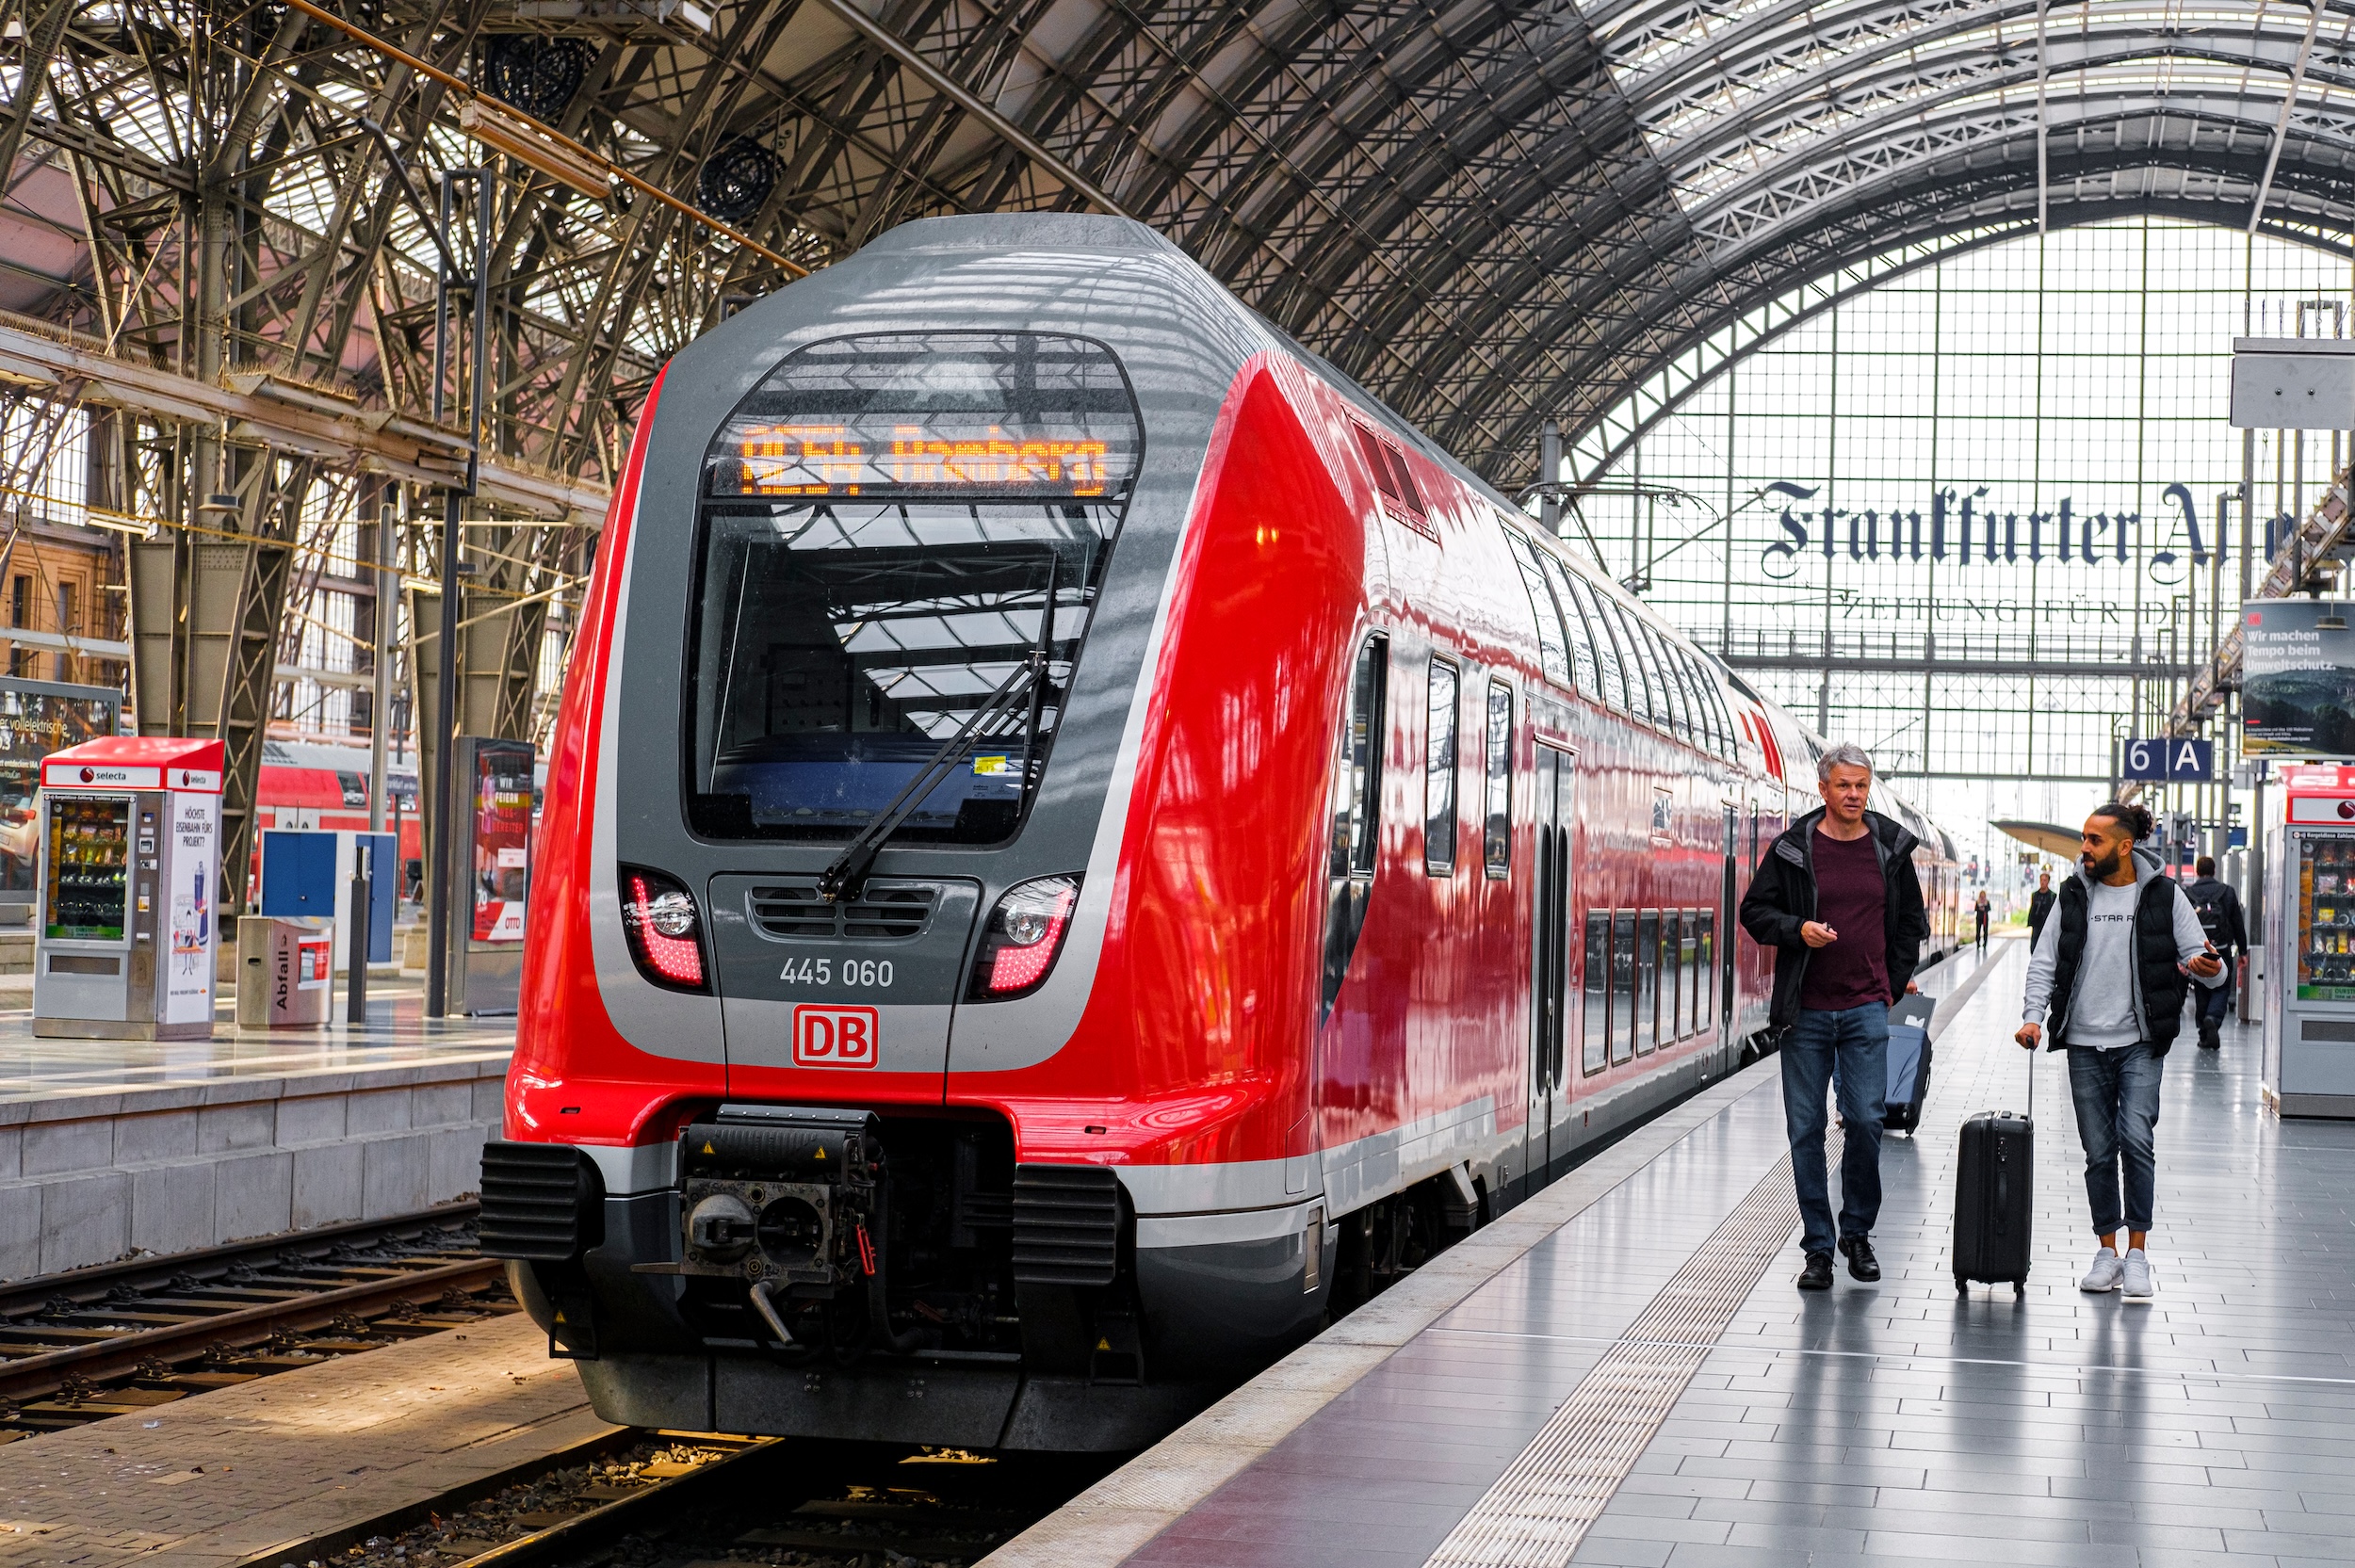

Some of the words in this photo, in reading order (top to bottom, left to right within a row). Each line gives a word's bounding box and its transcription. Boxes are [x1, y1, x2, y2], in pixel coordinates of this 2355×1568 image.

[1761, 481, 2141, 585] Frankfurter
[1843, 597, 2018, 622] ZEITUNG
[2043, 593, 2120, 623] FÜR
[2247, 630, 2267, 642] Wir
[2269, 630, 2320, 641] machen
[2247, 645, 2284, 658] Tempo
[2287, 644, 2321, 656] beim
[2247, 659, 2336, 671] Umweltschutz.
[9, 717, 68, 735] vollelektrische
[2130, 740, 2150, 771] 6
[2174, 740, 2201, 771] A
[96, 771, 127, 781] selecta
[190, 775, 206, 784] selecta
[499, 777, 513, 789] WIR
[495, 792, 519, 804] FEIERN
[185, 806, 205, 819] HÖCHSTE
[176, 821, 201, 833] EISENBAHN
[202, 820, 213, 833] FÜRS
[183, 835, 205, 848] PROJEKT?
[505, 916, 520, 929] OTTO
[780, 957, 831, 985] 445
[842, 959, 894, 988] 060
[276, 950, 288, 1010] Abfall
[804, 1014, 869, 1059] DB
